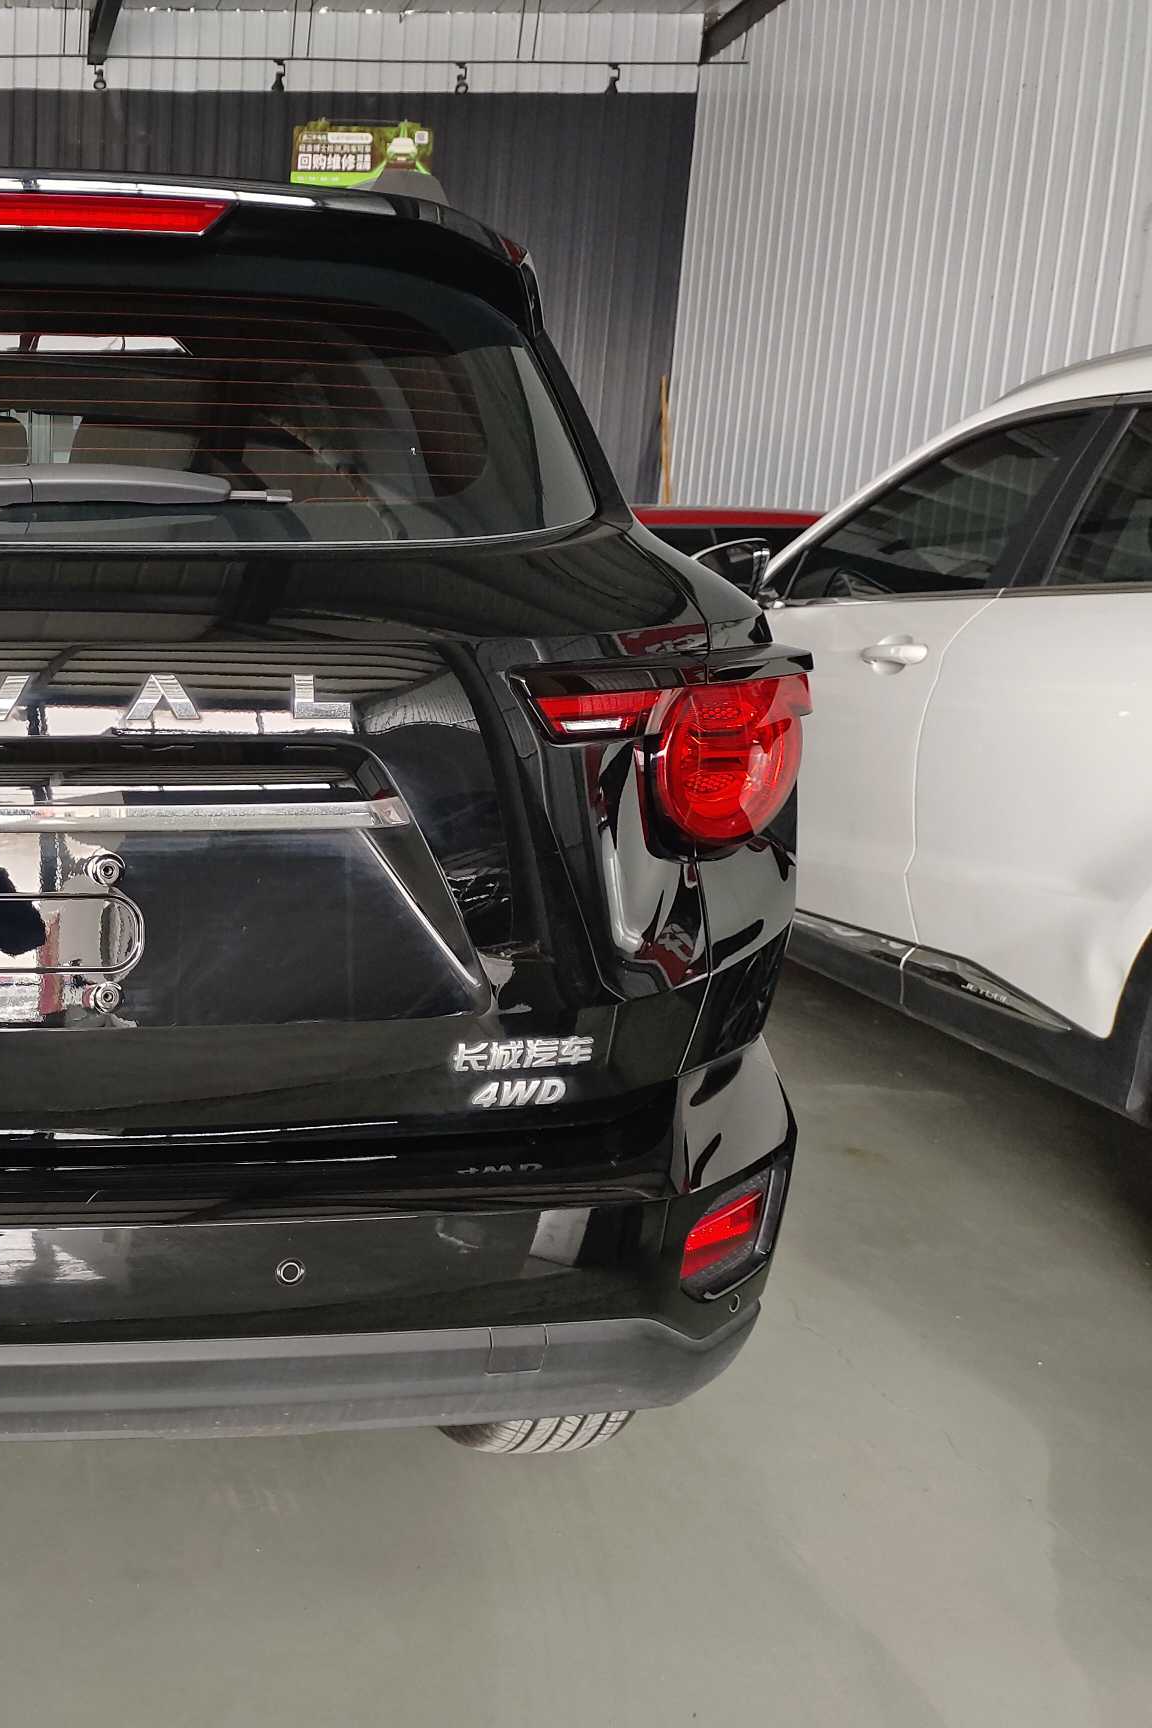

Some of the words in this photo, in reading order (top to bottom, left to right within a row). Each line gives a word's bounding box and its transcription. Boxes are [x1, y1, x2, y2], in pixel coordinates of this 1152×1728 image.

[453, 1036, 594, 1072] 长城汽车
[472, 1077, 567, 1107] 4WD
